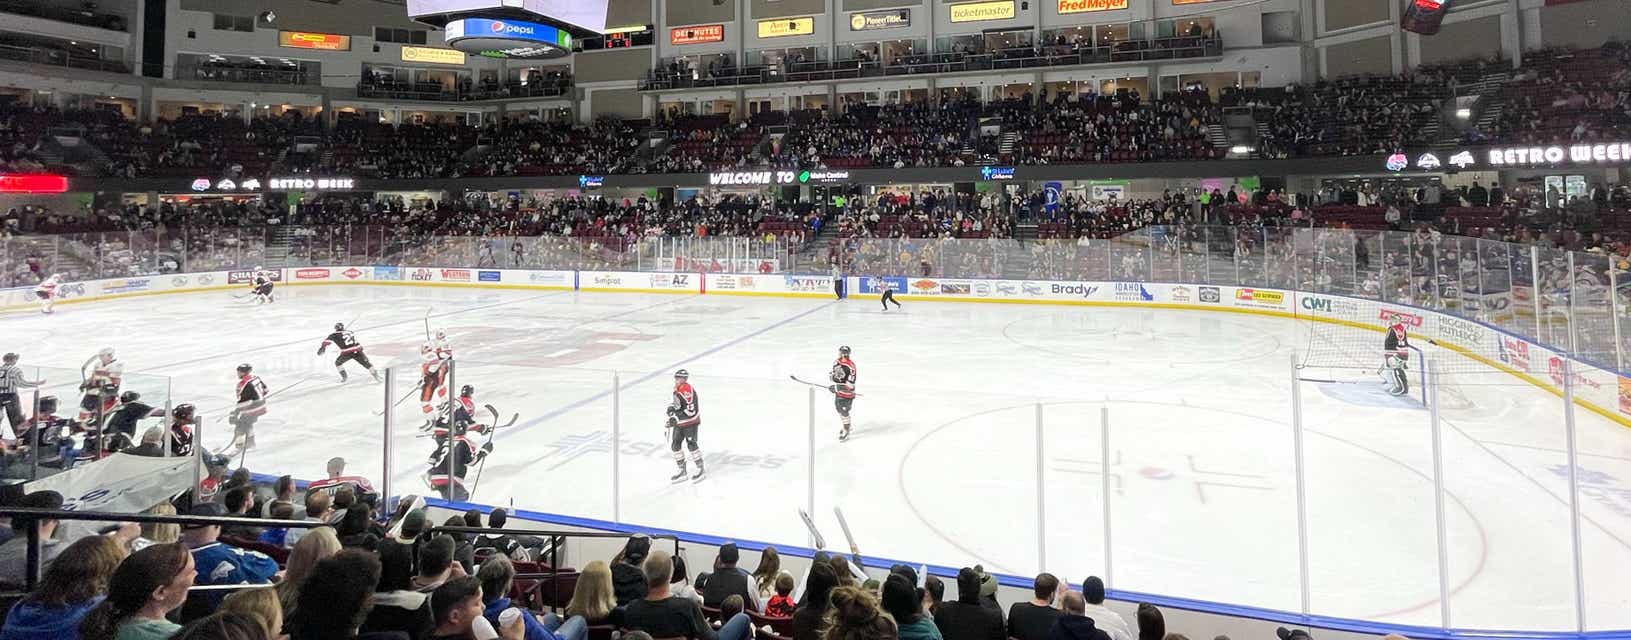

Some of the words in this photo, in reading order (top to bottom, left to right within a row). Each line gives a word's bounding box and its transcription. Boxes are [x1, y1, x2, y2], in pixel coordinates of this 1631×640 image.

[953, 6, 1010, 18] ticketmaster
[506, 25, 534, 35] pepsi
[1489, 146, 1564, 165] RETRO
[710, 172, 771, 185] WELCOME
[777, 171, 795, 183] TO
[270, 179, 315, 189] RETRO
[318, 179, 353, 189] WEEK
[595, 275, 631, 285] Simplot
[673, 274, 688, 285] AZ
[1052, 284, 1092, 298] Brady
[1115, 283, 1139, 292] IDAHO
[1302, 296, 1332, 312] CWI
